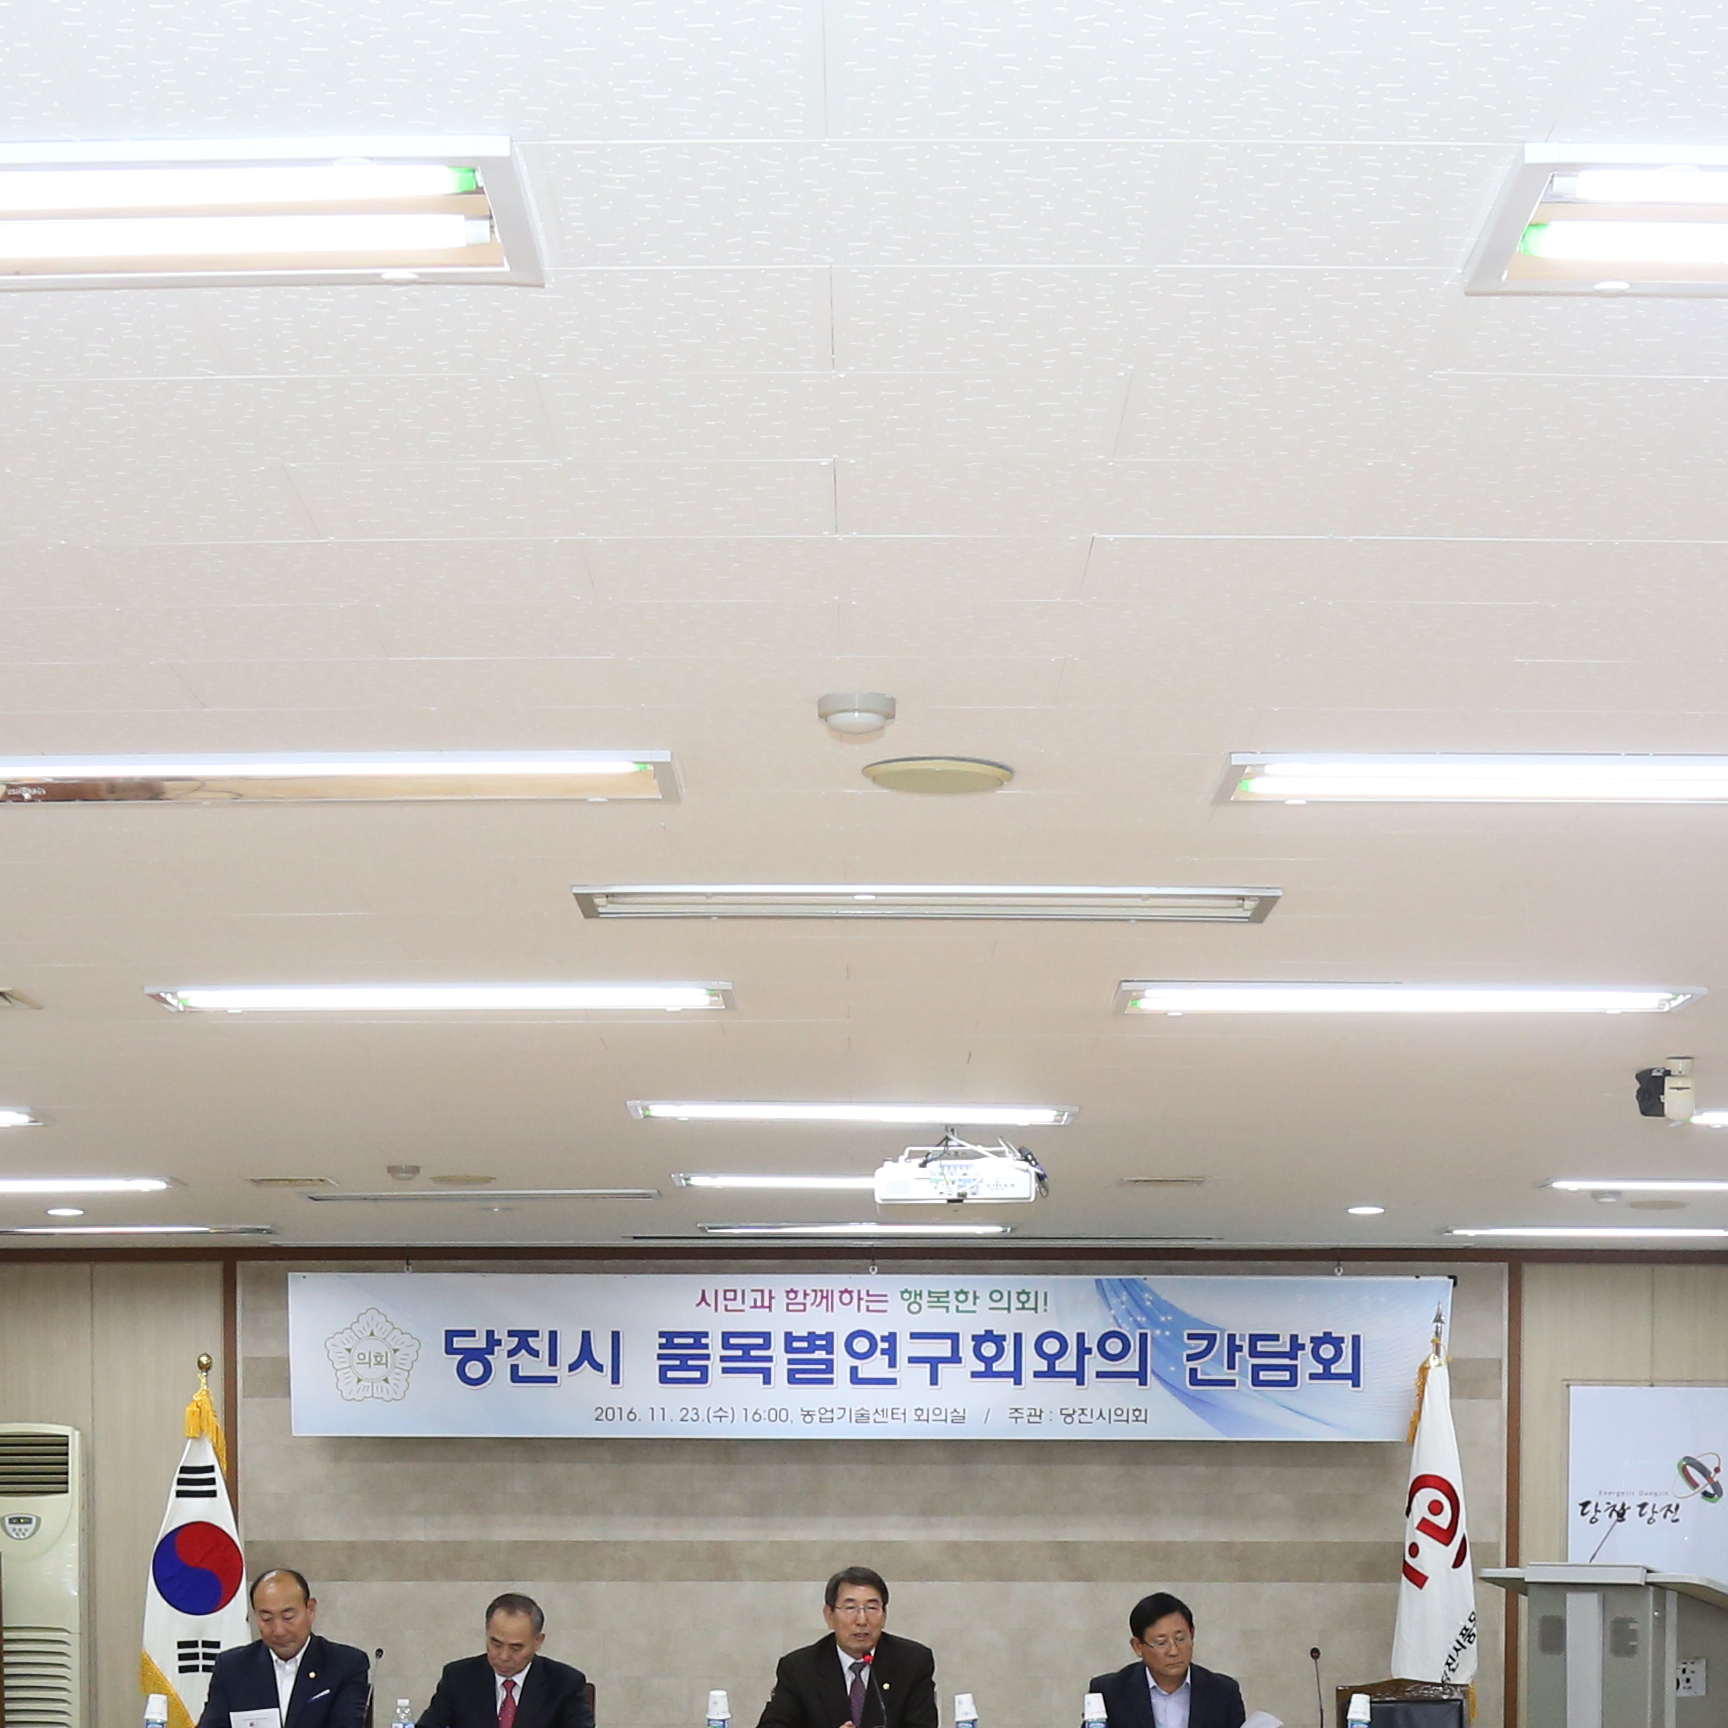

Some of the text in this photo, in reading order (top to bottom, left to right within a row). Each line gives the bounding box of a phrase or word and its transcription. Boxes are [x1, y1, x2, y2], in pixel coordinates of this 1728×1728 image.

[696, 1288, 1049, 1315] 시민과 함께하는 행복한 의회!
[355, 1350, 389, 1369] 의회
[445, 1329, 1363, 1389] 당진시 품목별연구회와의 간담회
[594, 1406, 642, 1422] 2016.
[649, 1406, 674, 1422] 11.
[679, 1406, 735, 1424] 23.(수)
[800, 1407, 907, 1424] 농업기술센터
[915, 1407, 967, 1424] 회의실
[1008, 1408, 1044, 1425] 주관
[1059, 1408, 1149, 1425] 당진시의회
[1636, 1501, 1681, 1525] 당진
